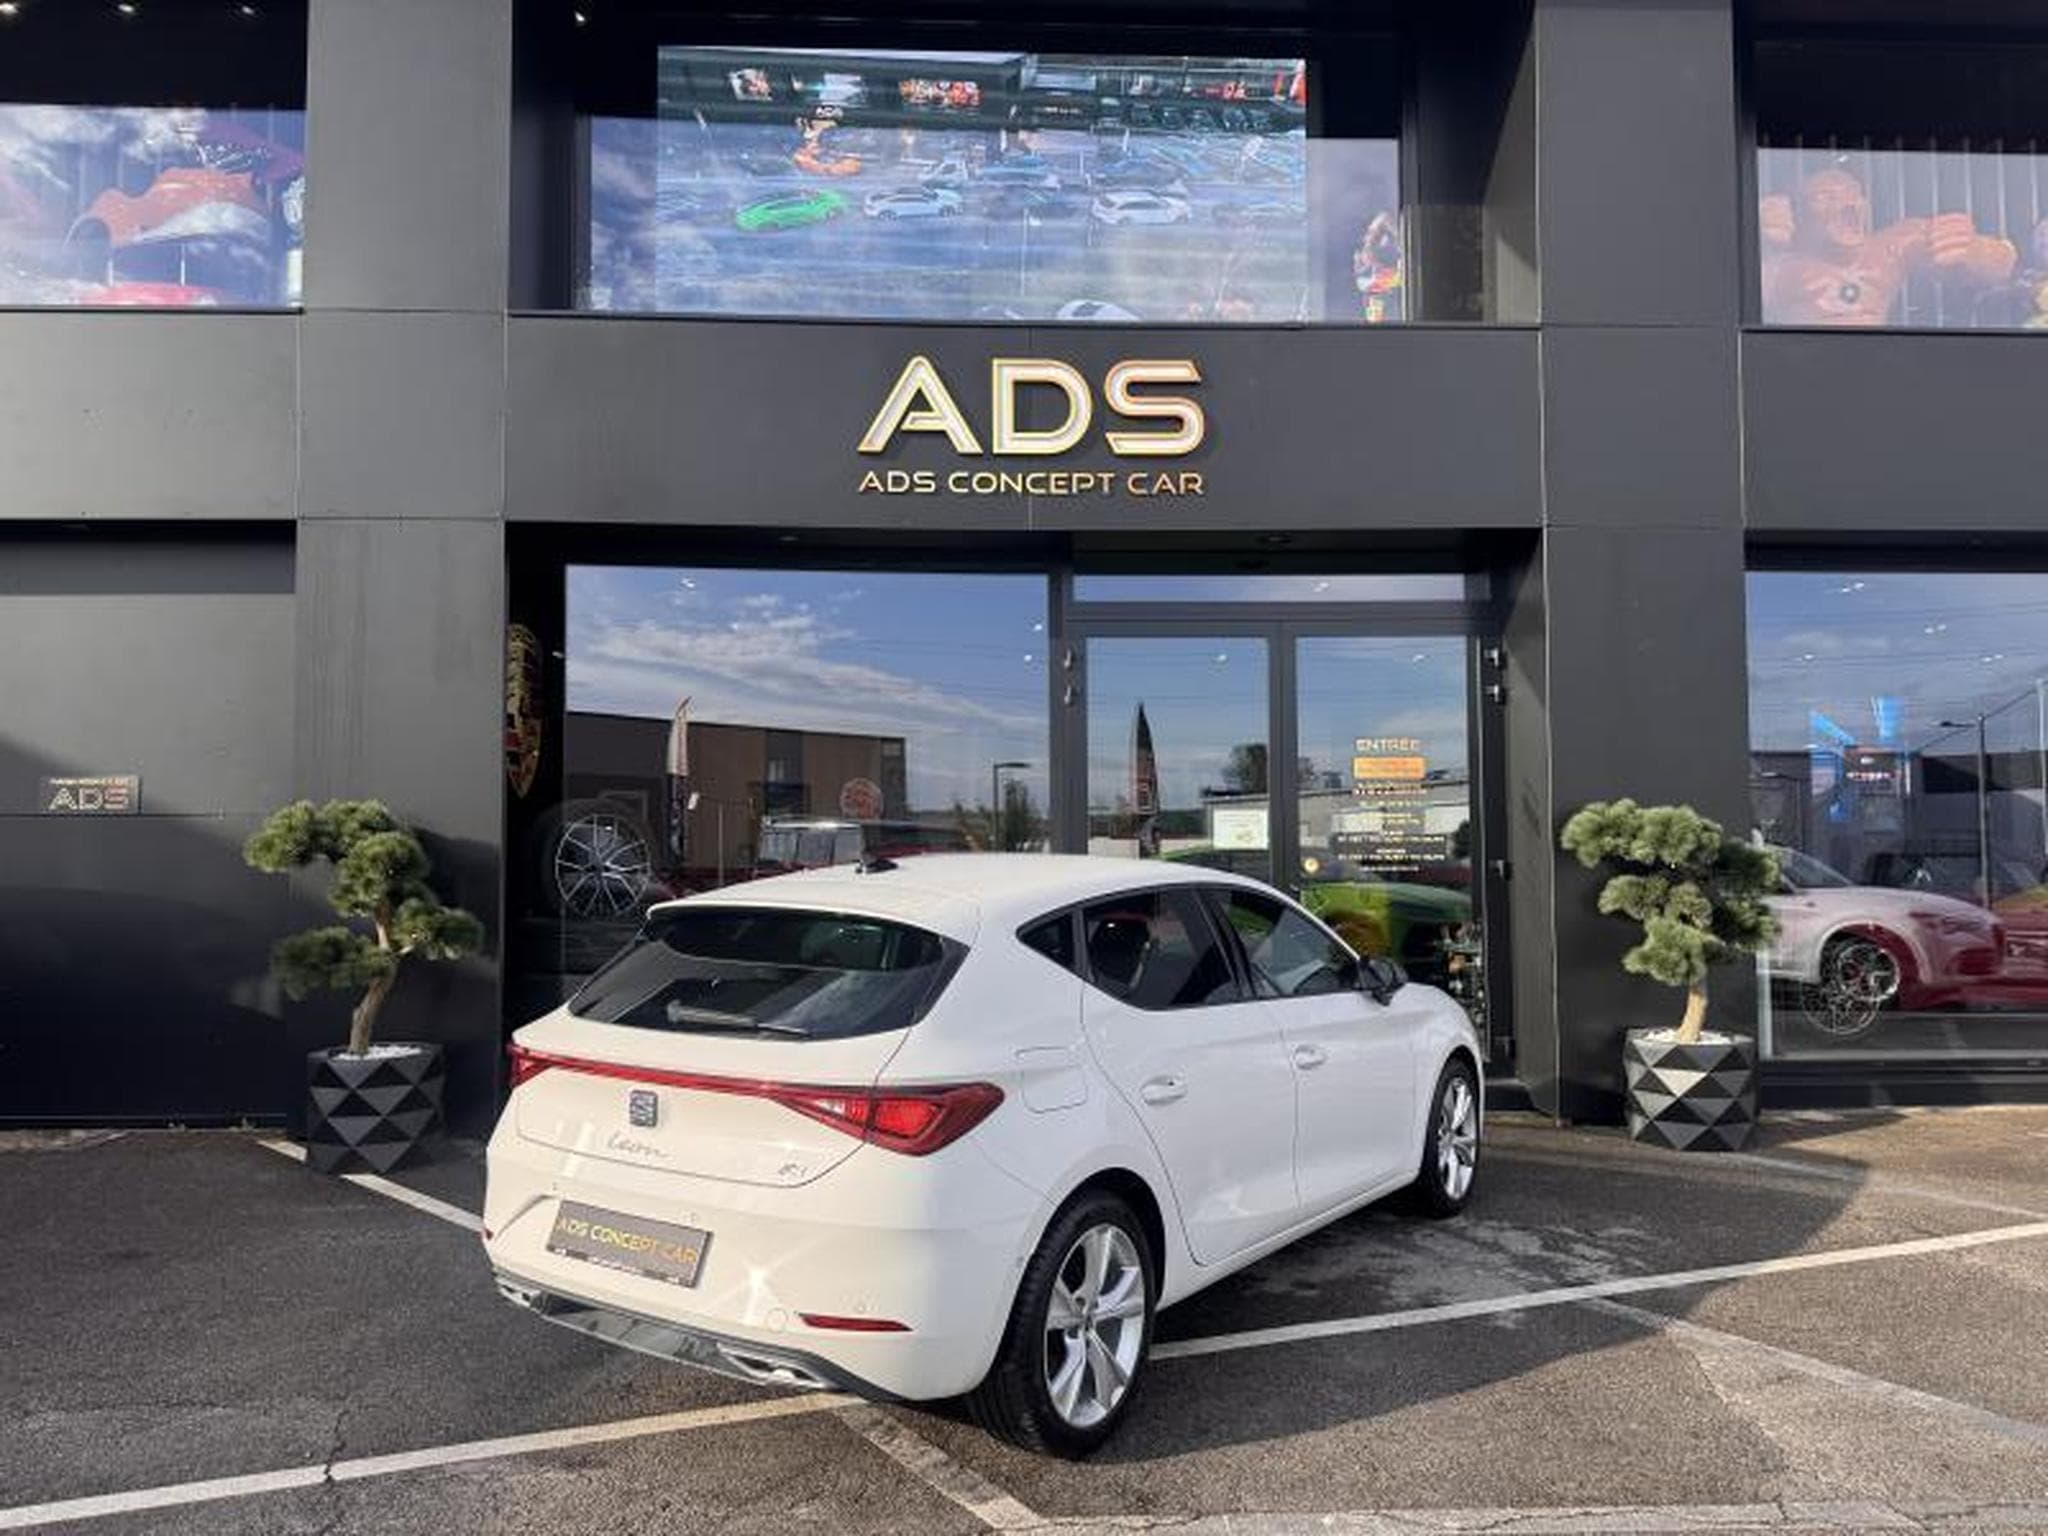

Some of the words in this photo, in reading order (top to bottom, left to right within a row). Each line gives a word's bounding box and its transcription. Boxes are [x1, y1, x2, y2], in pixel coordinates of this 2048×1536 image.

[857, 355, 1205, 455] ADS
[858, 471, 936, 494] ADS
[948, 471, 1115, 494] CONCEPT
[1127, 473, 1205, 495] CAR
[49, 787, 129, 810] ADS
[555, 1217, 590, 1237] ADS
[590, 1224, 657, 1251] CONCEPT
